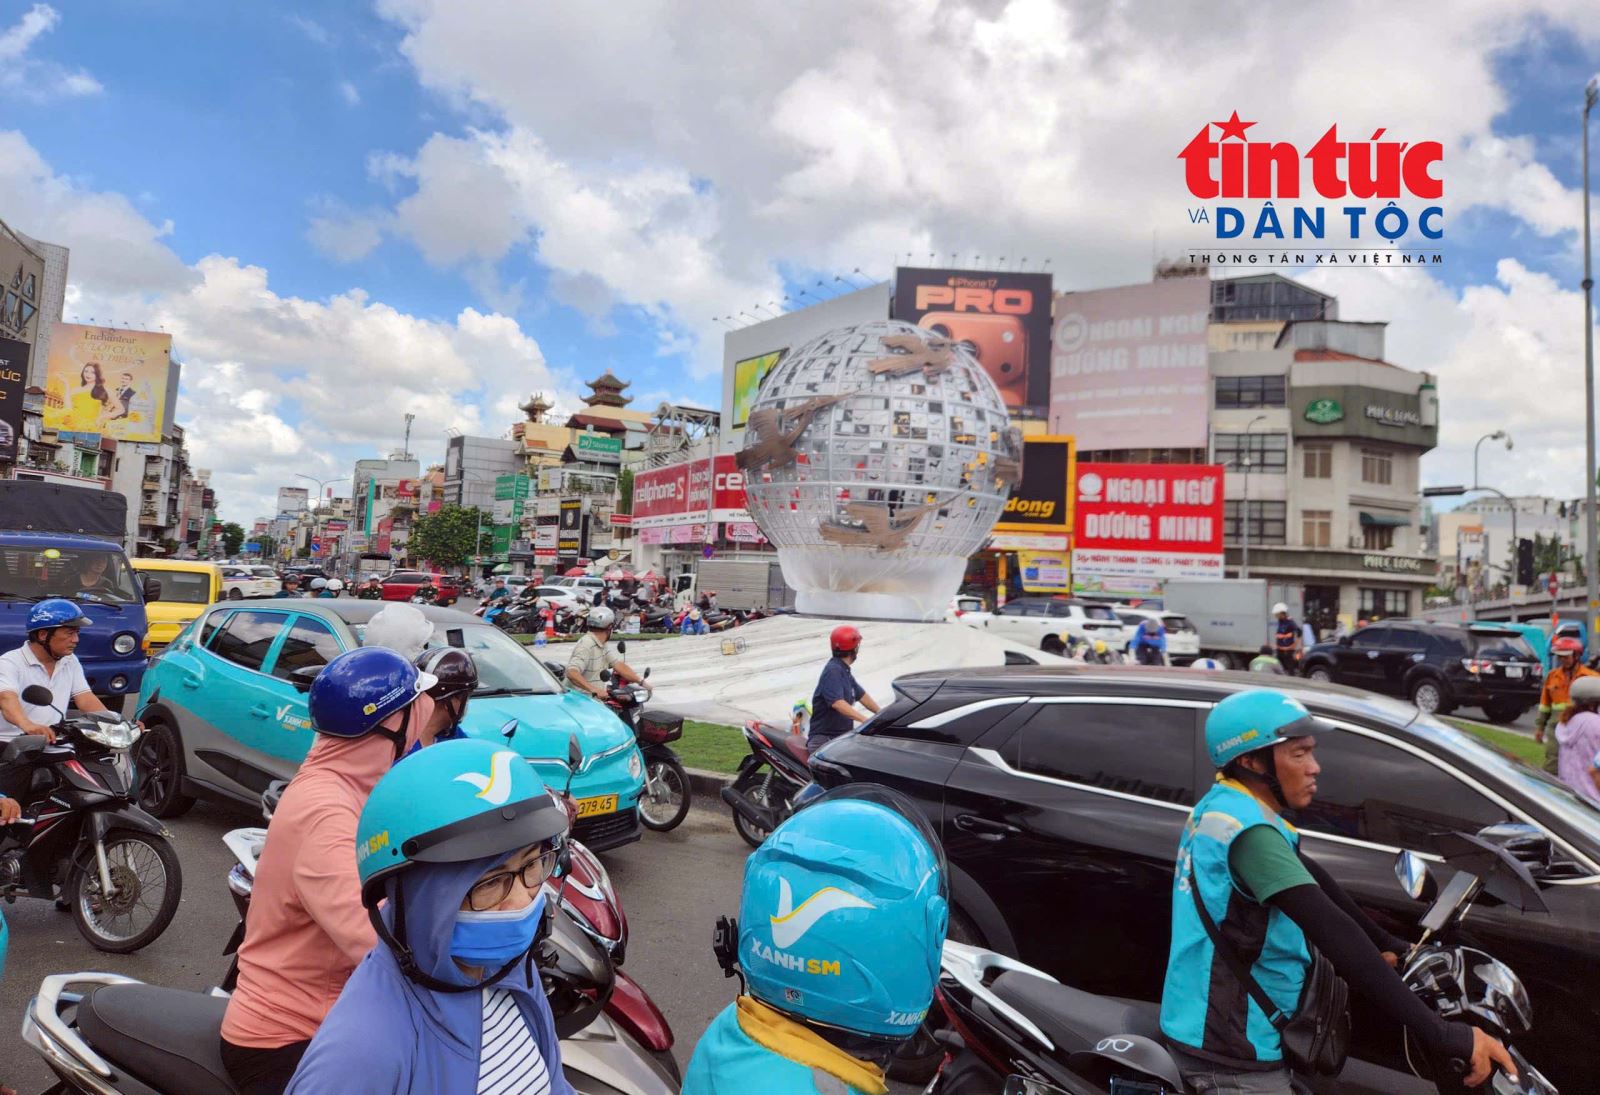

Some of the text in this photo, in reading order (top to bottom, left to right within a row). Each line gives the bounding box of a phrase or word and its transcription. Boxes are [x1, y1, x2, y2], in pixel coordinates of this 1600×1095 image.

[957, 278, 998, 288] iPhone 17
[916, 284, 1032, 315] PRO
[84, 330, 137, 344] Enchanteur
[1106, 476, 1216, 508] NGOẠI NGỮ
[1158, 515, 1213, 542] MINH
[1216, 735, 1242, 754] XANH
[50, 796, 71, 808] HONDA
[369, 830, 389, 854] SM
[751, 937, 840, 976] XANH SM
[884, 1010, 921, 1026] XANH
